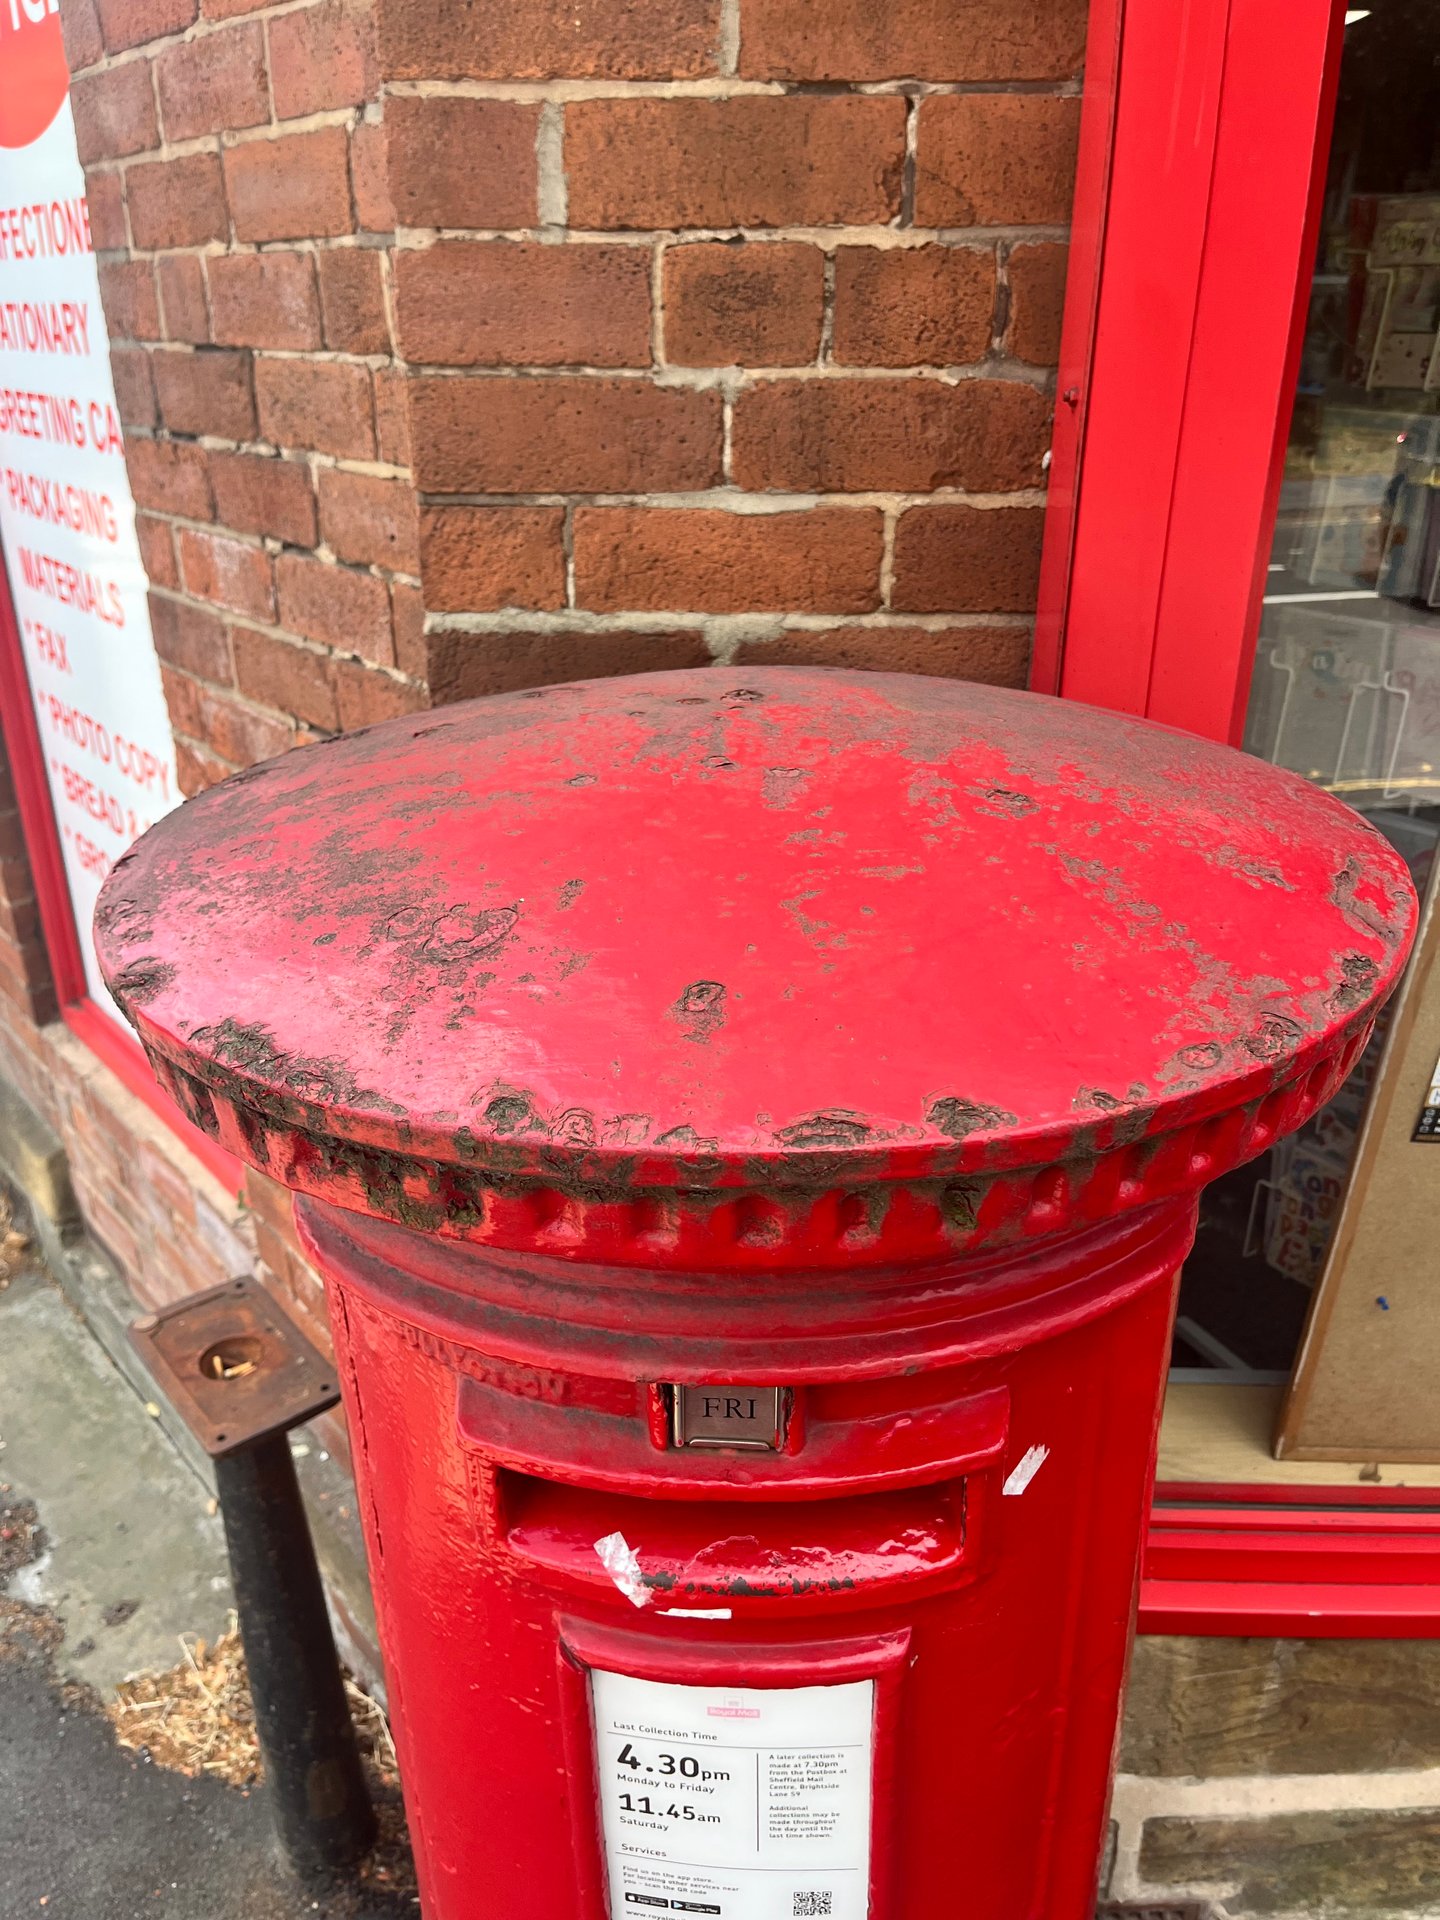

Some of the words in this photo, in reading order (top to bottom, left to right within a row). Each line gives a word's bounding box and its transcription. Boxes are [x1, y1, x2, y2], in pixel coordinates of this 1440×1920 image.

[18, 546, 125, 629] MATERIALS
[114, 734, 169, 801] COPY
[701, 1397, 758, 1419] FRI
[613, 1721, 635, 1731] Last
[638, 1724, 689, 1738] Collection
[692, 1731, 718, 1741] Time
[617, 1743, 730, 1782] 4.30pm
[805, 1761, 839, 1769] 7.30pm
[617, 1773, 660, 1788] Monday
[664, 1781, 675, 1789] to
[680, 1782, 715, 1794] Friday
[618, 1793, 721, 1823] 11.45am
[620, 1816, 669, 1831] Saturday
[621, 1843, 667, 1857] Services
[637, 1874, 666, 1884] locating
[668, 1879, 688, 1887] other
